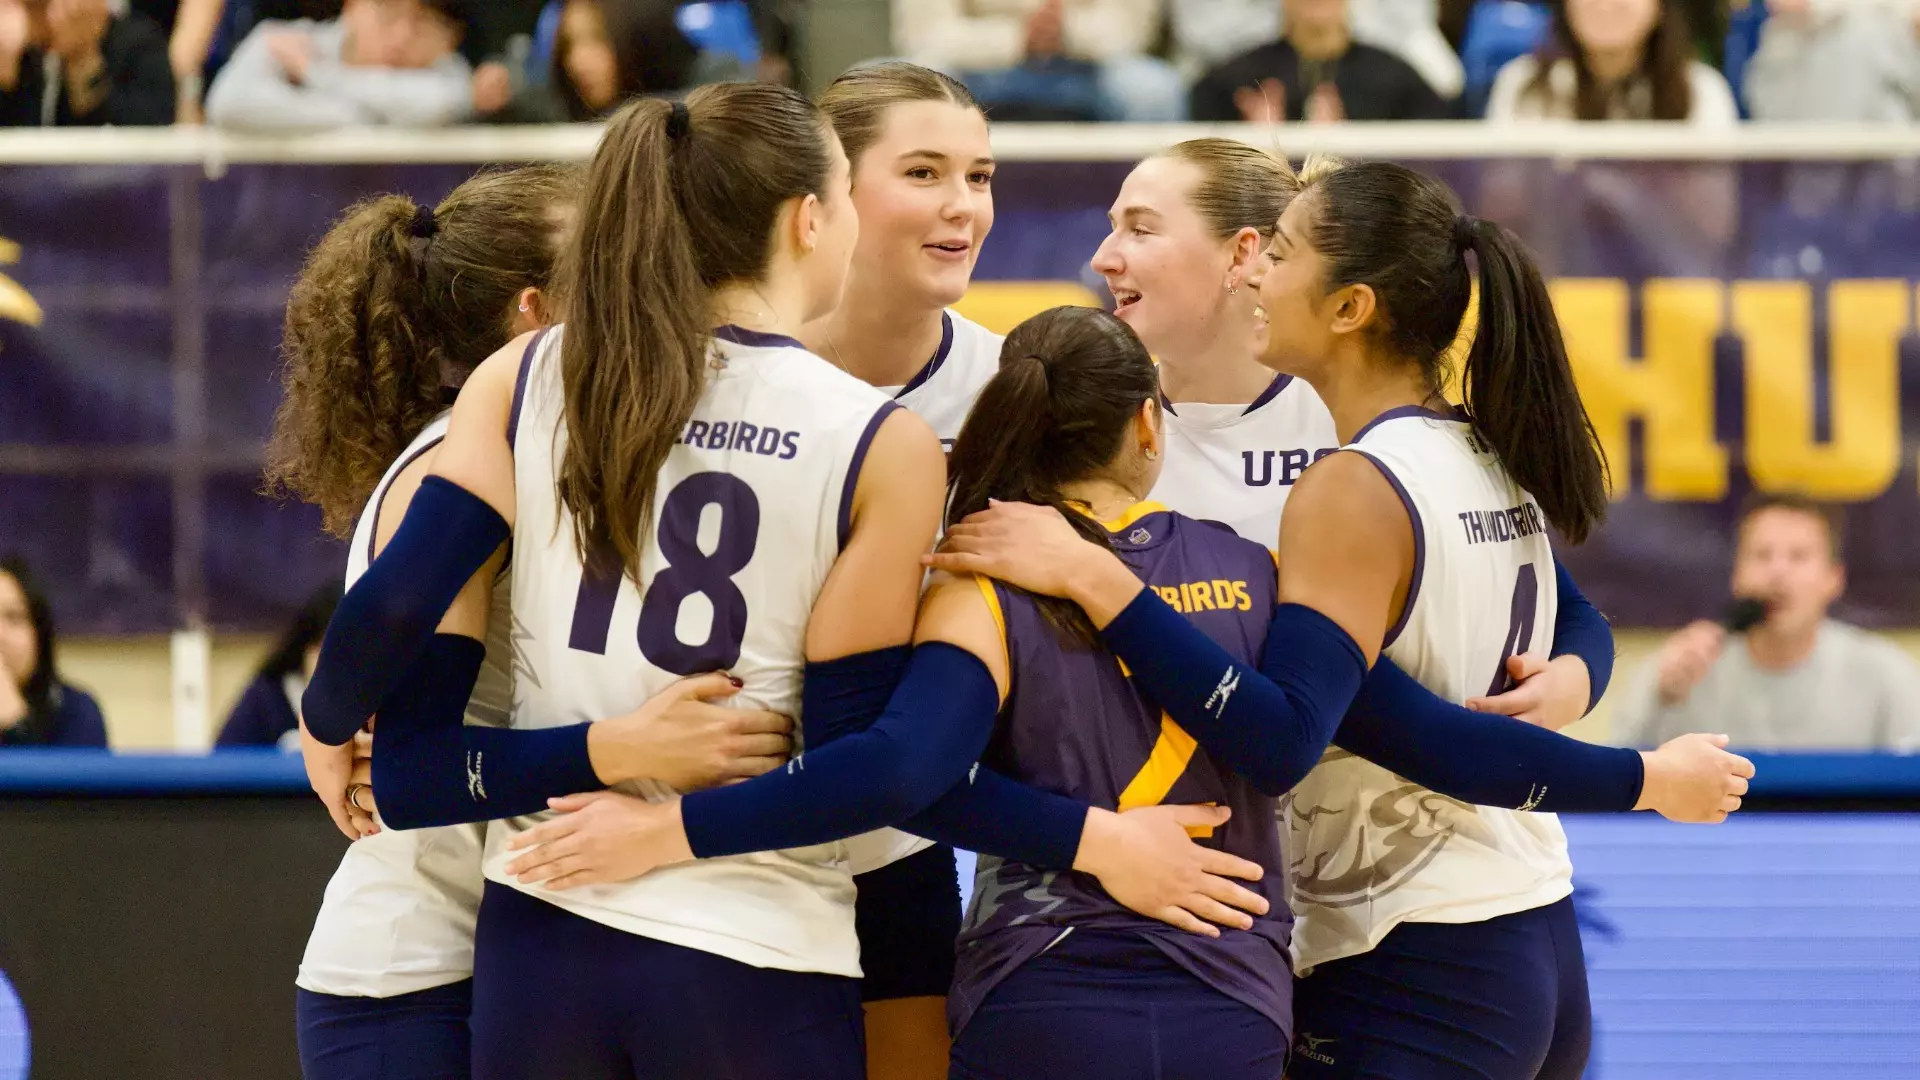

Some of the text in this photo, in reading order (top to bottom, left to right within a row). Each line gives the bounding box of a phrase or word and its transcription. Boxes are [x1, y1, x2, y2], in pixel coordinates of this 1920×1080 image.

[1542, 276, 1920, 501] HU
[674, 419, 800, 460] RBIRDS
[1149, 579, 1252, 613] BIRDS
